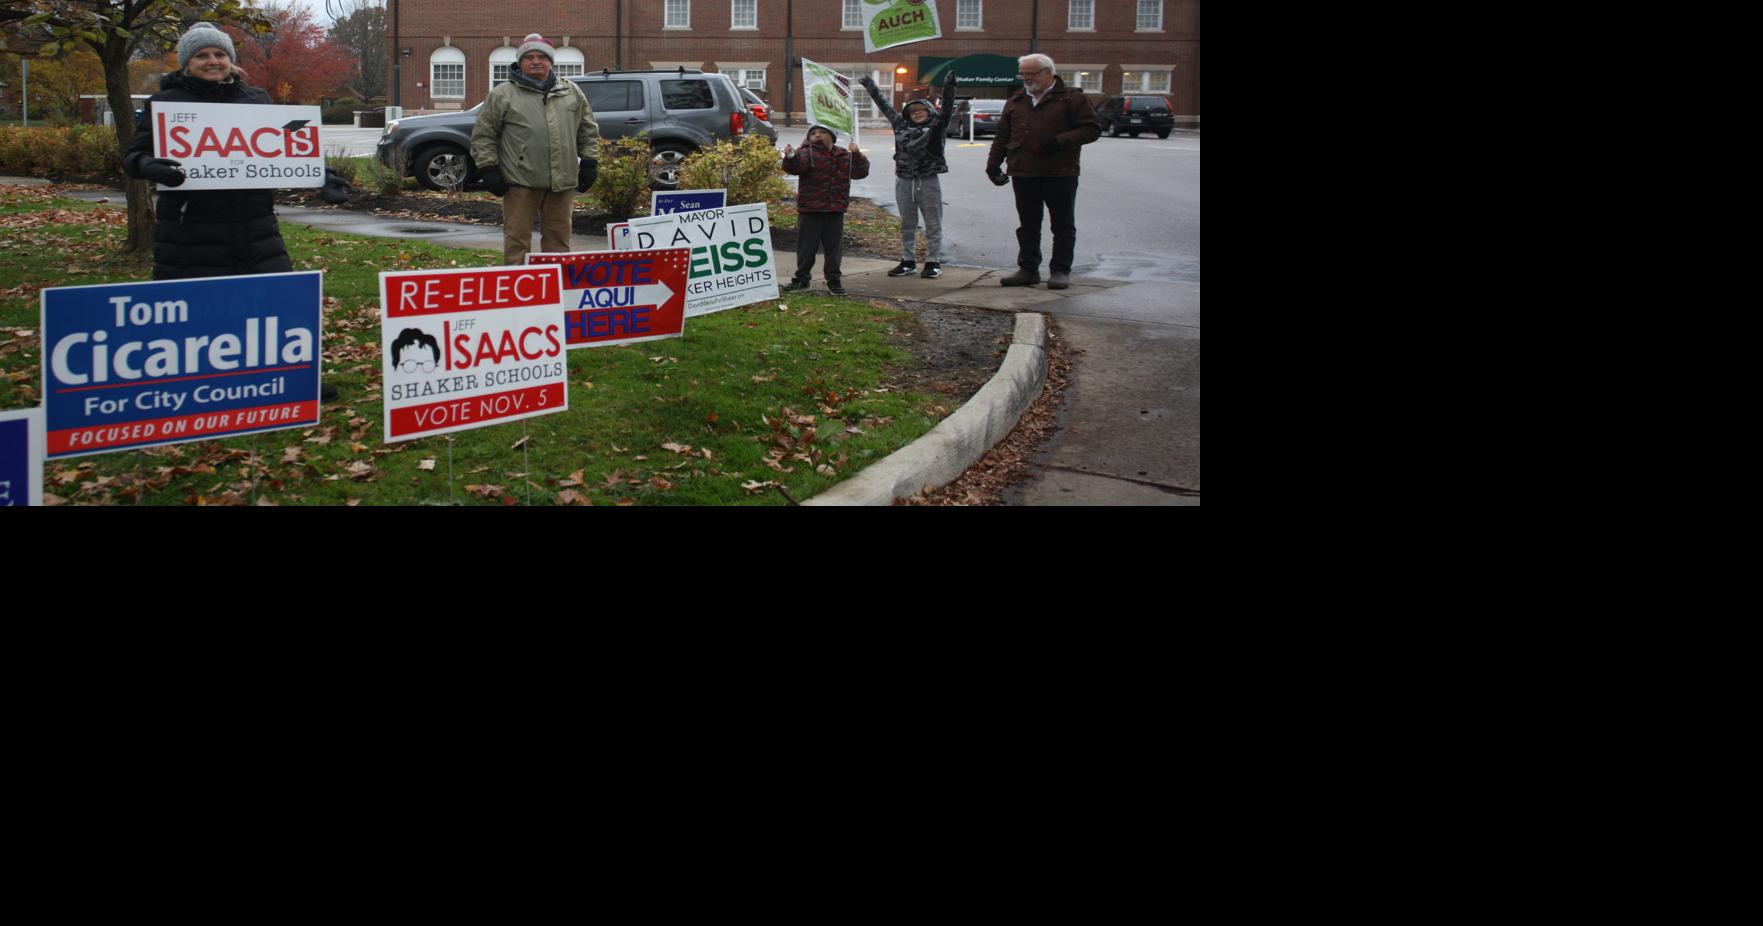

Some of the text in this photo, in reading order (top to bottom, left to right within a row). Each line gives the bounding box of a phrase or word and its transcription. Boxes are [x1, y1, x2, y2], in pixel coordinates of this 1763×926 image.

[878, 9, 924, 31] AUCH
[170, 113, 198, 123] JEFF
[246, 164, 321, 178] Schools
[678, 209, 724, 224] MAYOR
[680, 200, 701, 209] Sean
[638, 217, 764, 249] DAVID
[568, 258, 656, 287] VOTE
[689, 238, 768, 279] EISS
[400, 273, 551, 311] RE-ELECT
[687, 269, 771, 295] KER HEIGHTS
[109, 296, 189, 327] Tom
[578, 287, 635, 309] AQUI
[453, 318, 476, 331] JEFF
[565, 308, 652, 339] HERE
[51, 316, 314, 385] Cicarella
[443, 320, 561, 371] ISAACS
[85, 376, 285, 416] For City Council
[391, 362, 562, 400] SHAKER SCHOOLS
[414, 389, 548, 427] VOTE NOV. 5
[69, 405, 301, 446] FOCUSED ON OUR FUTURE
